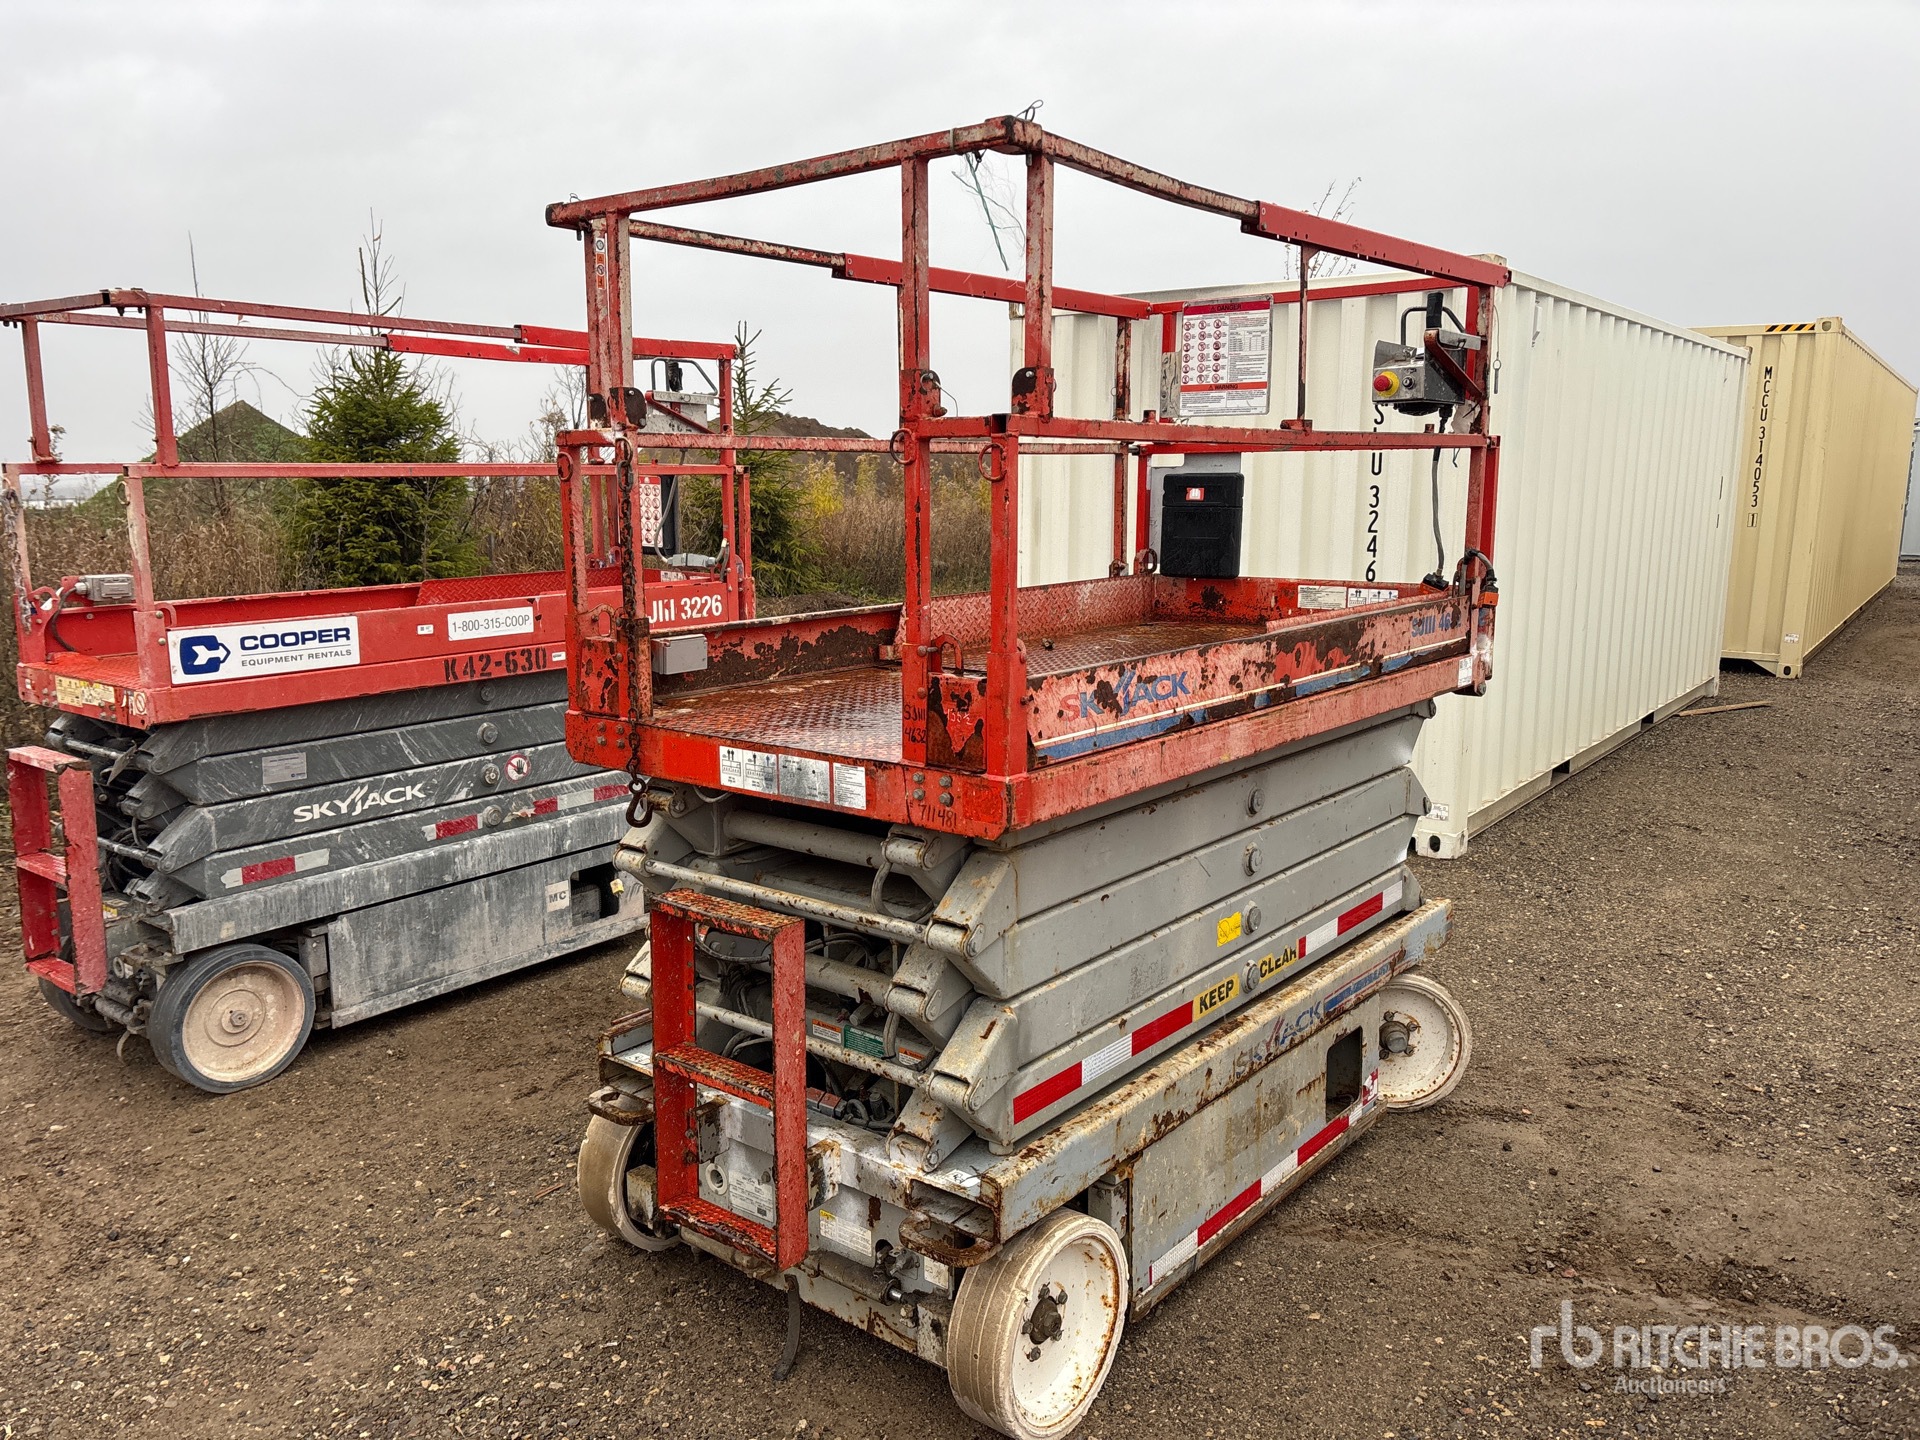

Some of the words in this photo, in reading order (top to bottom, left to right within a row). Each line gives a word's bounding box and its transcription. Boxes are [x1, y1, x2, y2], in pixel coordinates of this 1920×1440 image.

[1760, 366, 1773, 421] MCCU
[1751, 426, 1765, 508] 314053
[1365, 485, 1380, 582] 3246
[452, 614, 530, 633] 1-800-315-COOP
[681, 594, 722, 620] 3226
[240, 627, 351, 651] COOPER
[241, 654, 304, 667] EQUIPMENT
[308, 649, 352, 660] RENTALS
[444, 647, 547, 682] K42-630
[293, 784, 426, 823] SKYJACK
[548, 891, 567, 903] MC
[1199, 979, 1235, 1014] KEEP
